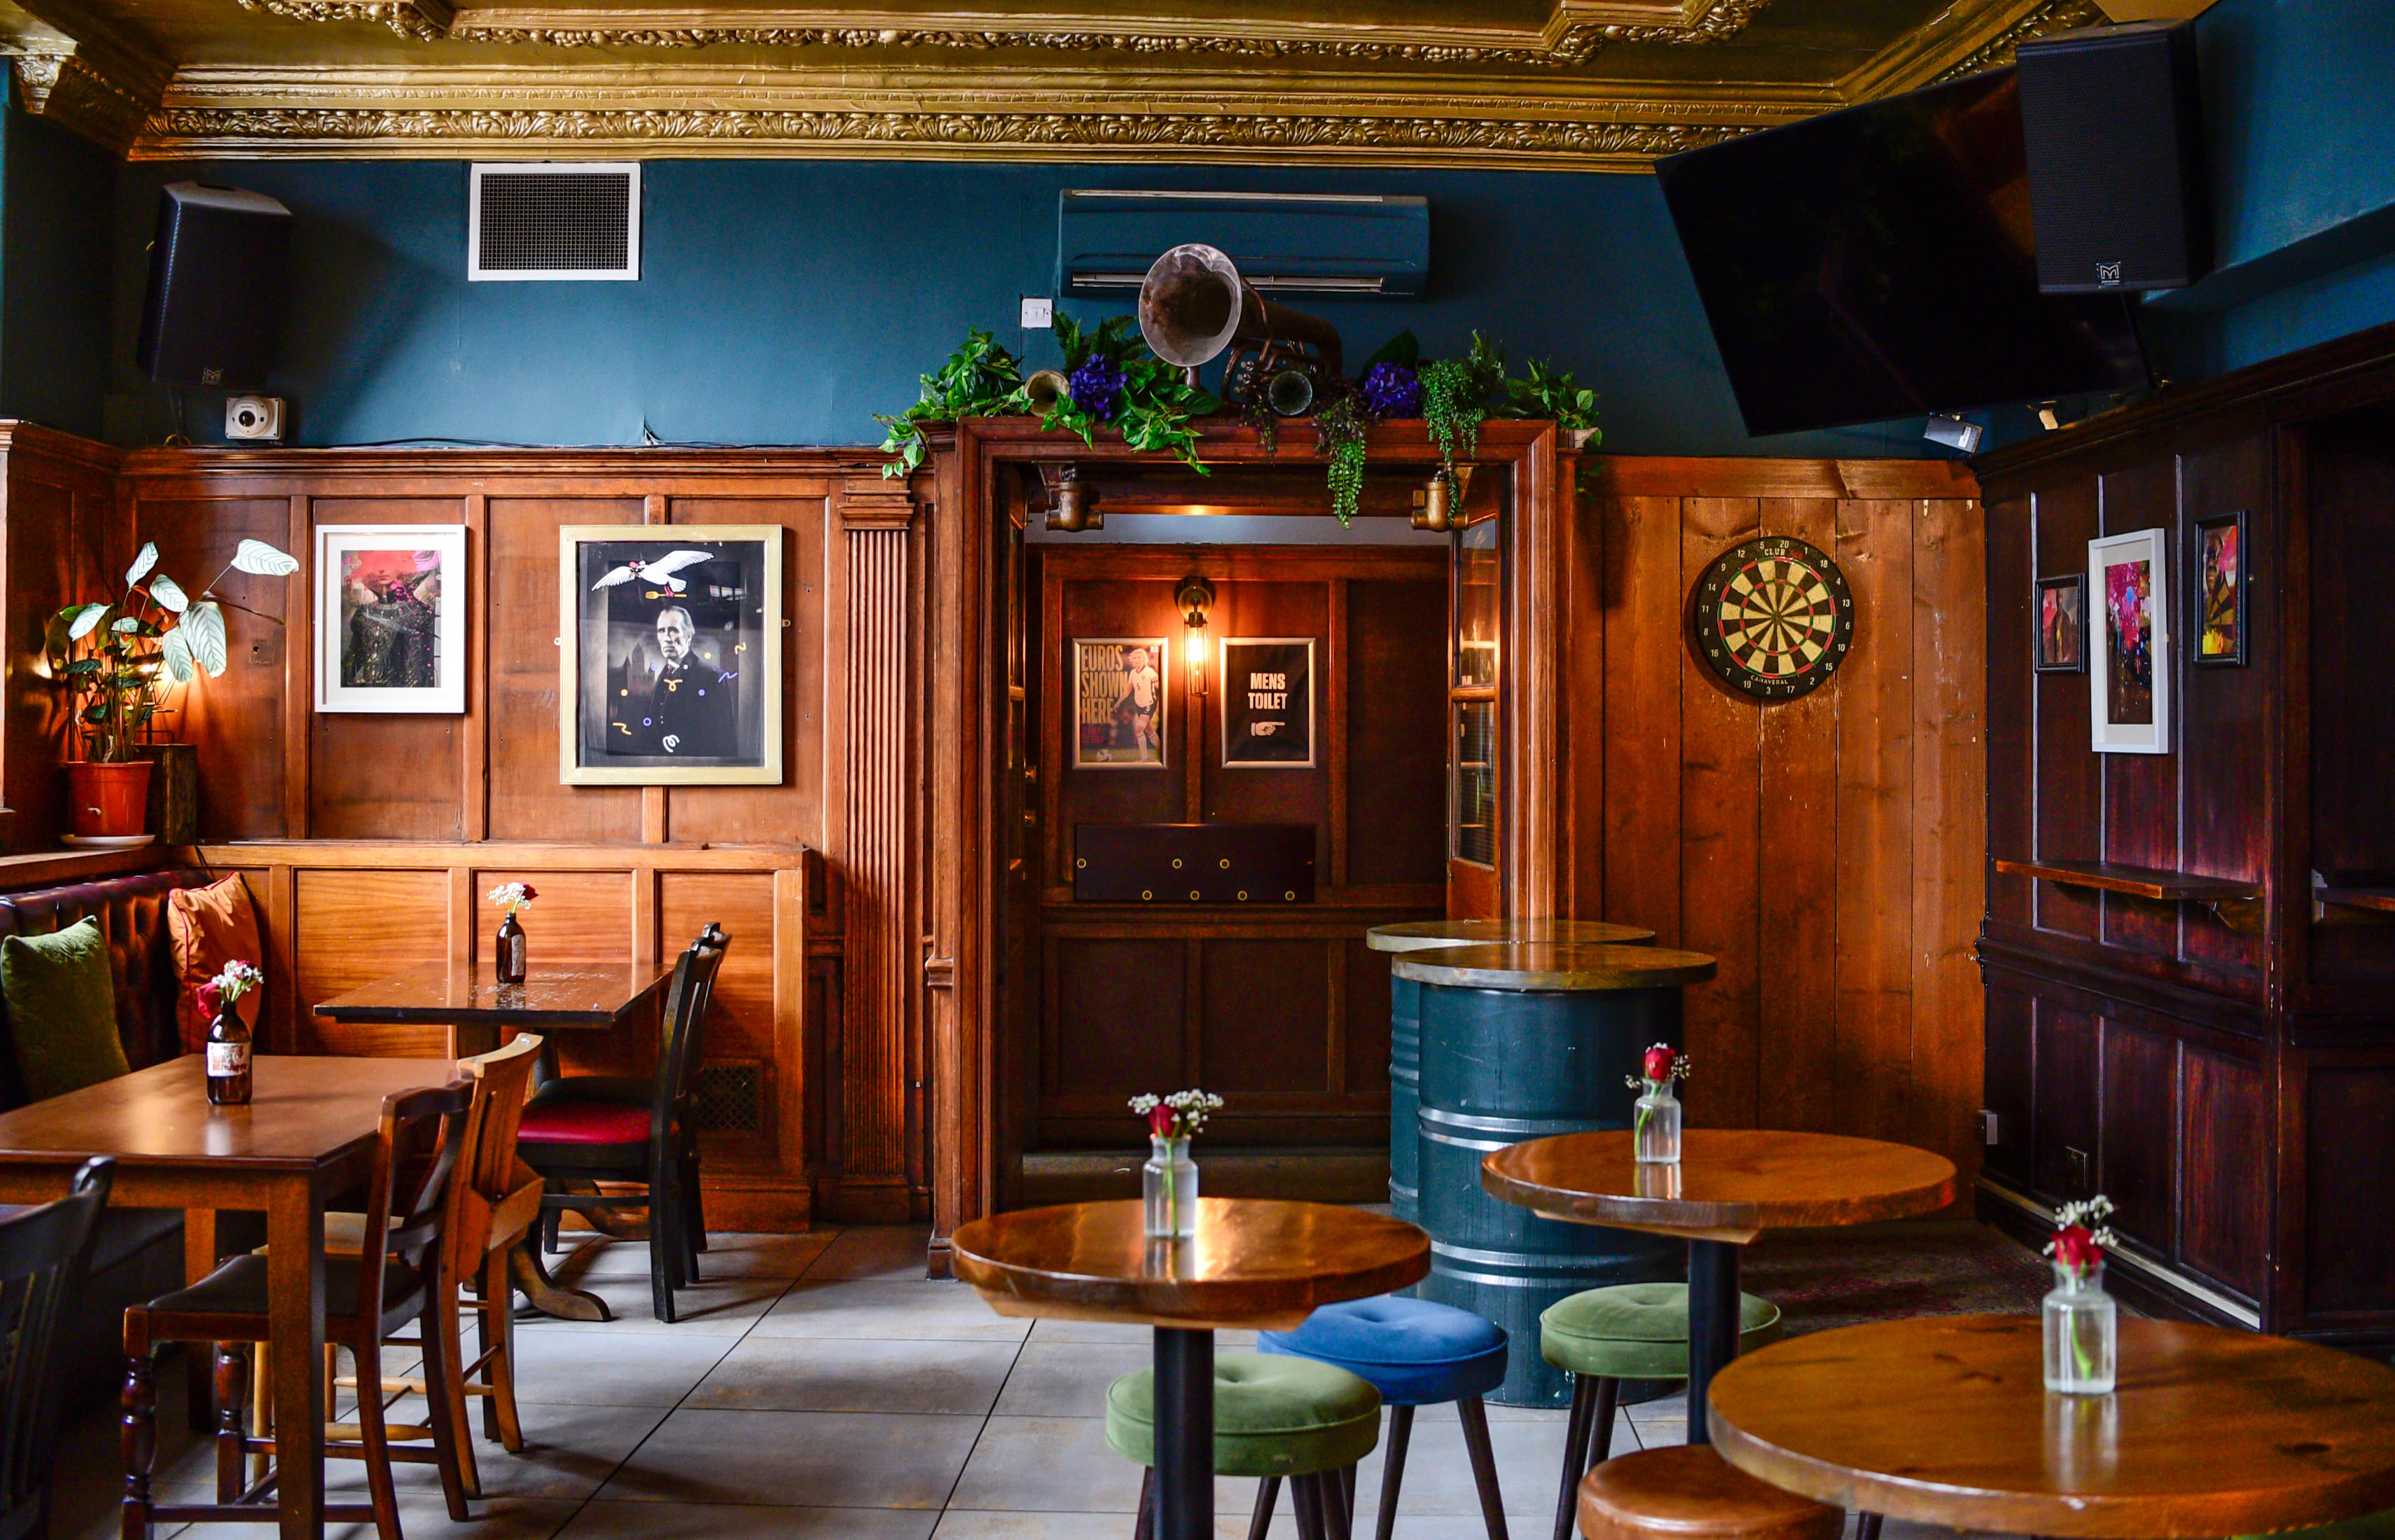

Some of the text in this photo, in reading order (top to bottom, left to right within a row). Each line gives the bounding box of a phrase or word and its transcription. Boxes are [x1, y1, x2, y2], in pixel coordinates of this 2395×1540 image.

[1759, 541, 1764, 550] 5
[1780, 540, 1789, 548] 20
[1737, 550, 1745, 558] 12
[1764, 548, 1785, 556] CLUB
[1721, 563, 1726, 571] 9
[1820, 559, 1828, 568] 18
[1842, 599, 1850, 607] 13
[1701, 605, 1709, 613] 11
[1846, 622, 1850, 630] 6
[1837, 644, 1845, 652] 10
[1711, 649, 1718, 657] 16
[1081, 645, 1123, 671] EUROS
[1825, 662, 1833, 671] 15
[1726, 668, 1731, 677] 7
[1081, 671, 1128, 698] SHOWN
[1251, 673, 1285, 690] MENS
[1743, 680, 1751, 689] 19
[1751, 675, 1788, 685] CANAVERAL
[1248, 692, 1287, 709] TOILET
[1082, 698, 1113, 724] HERE
